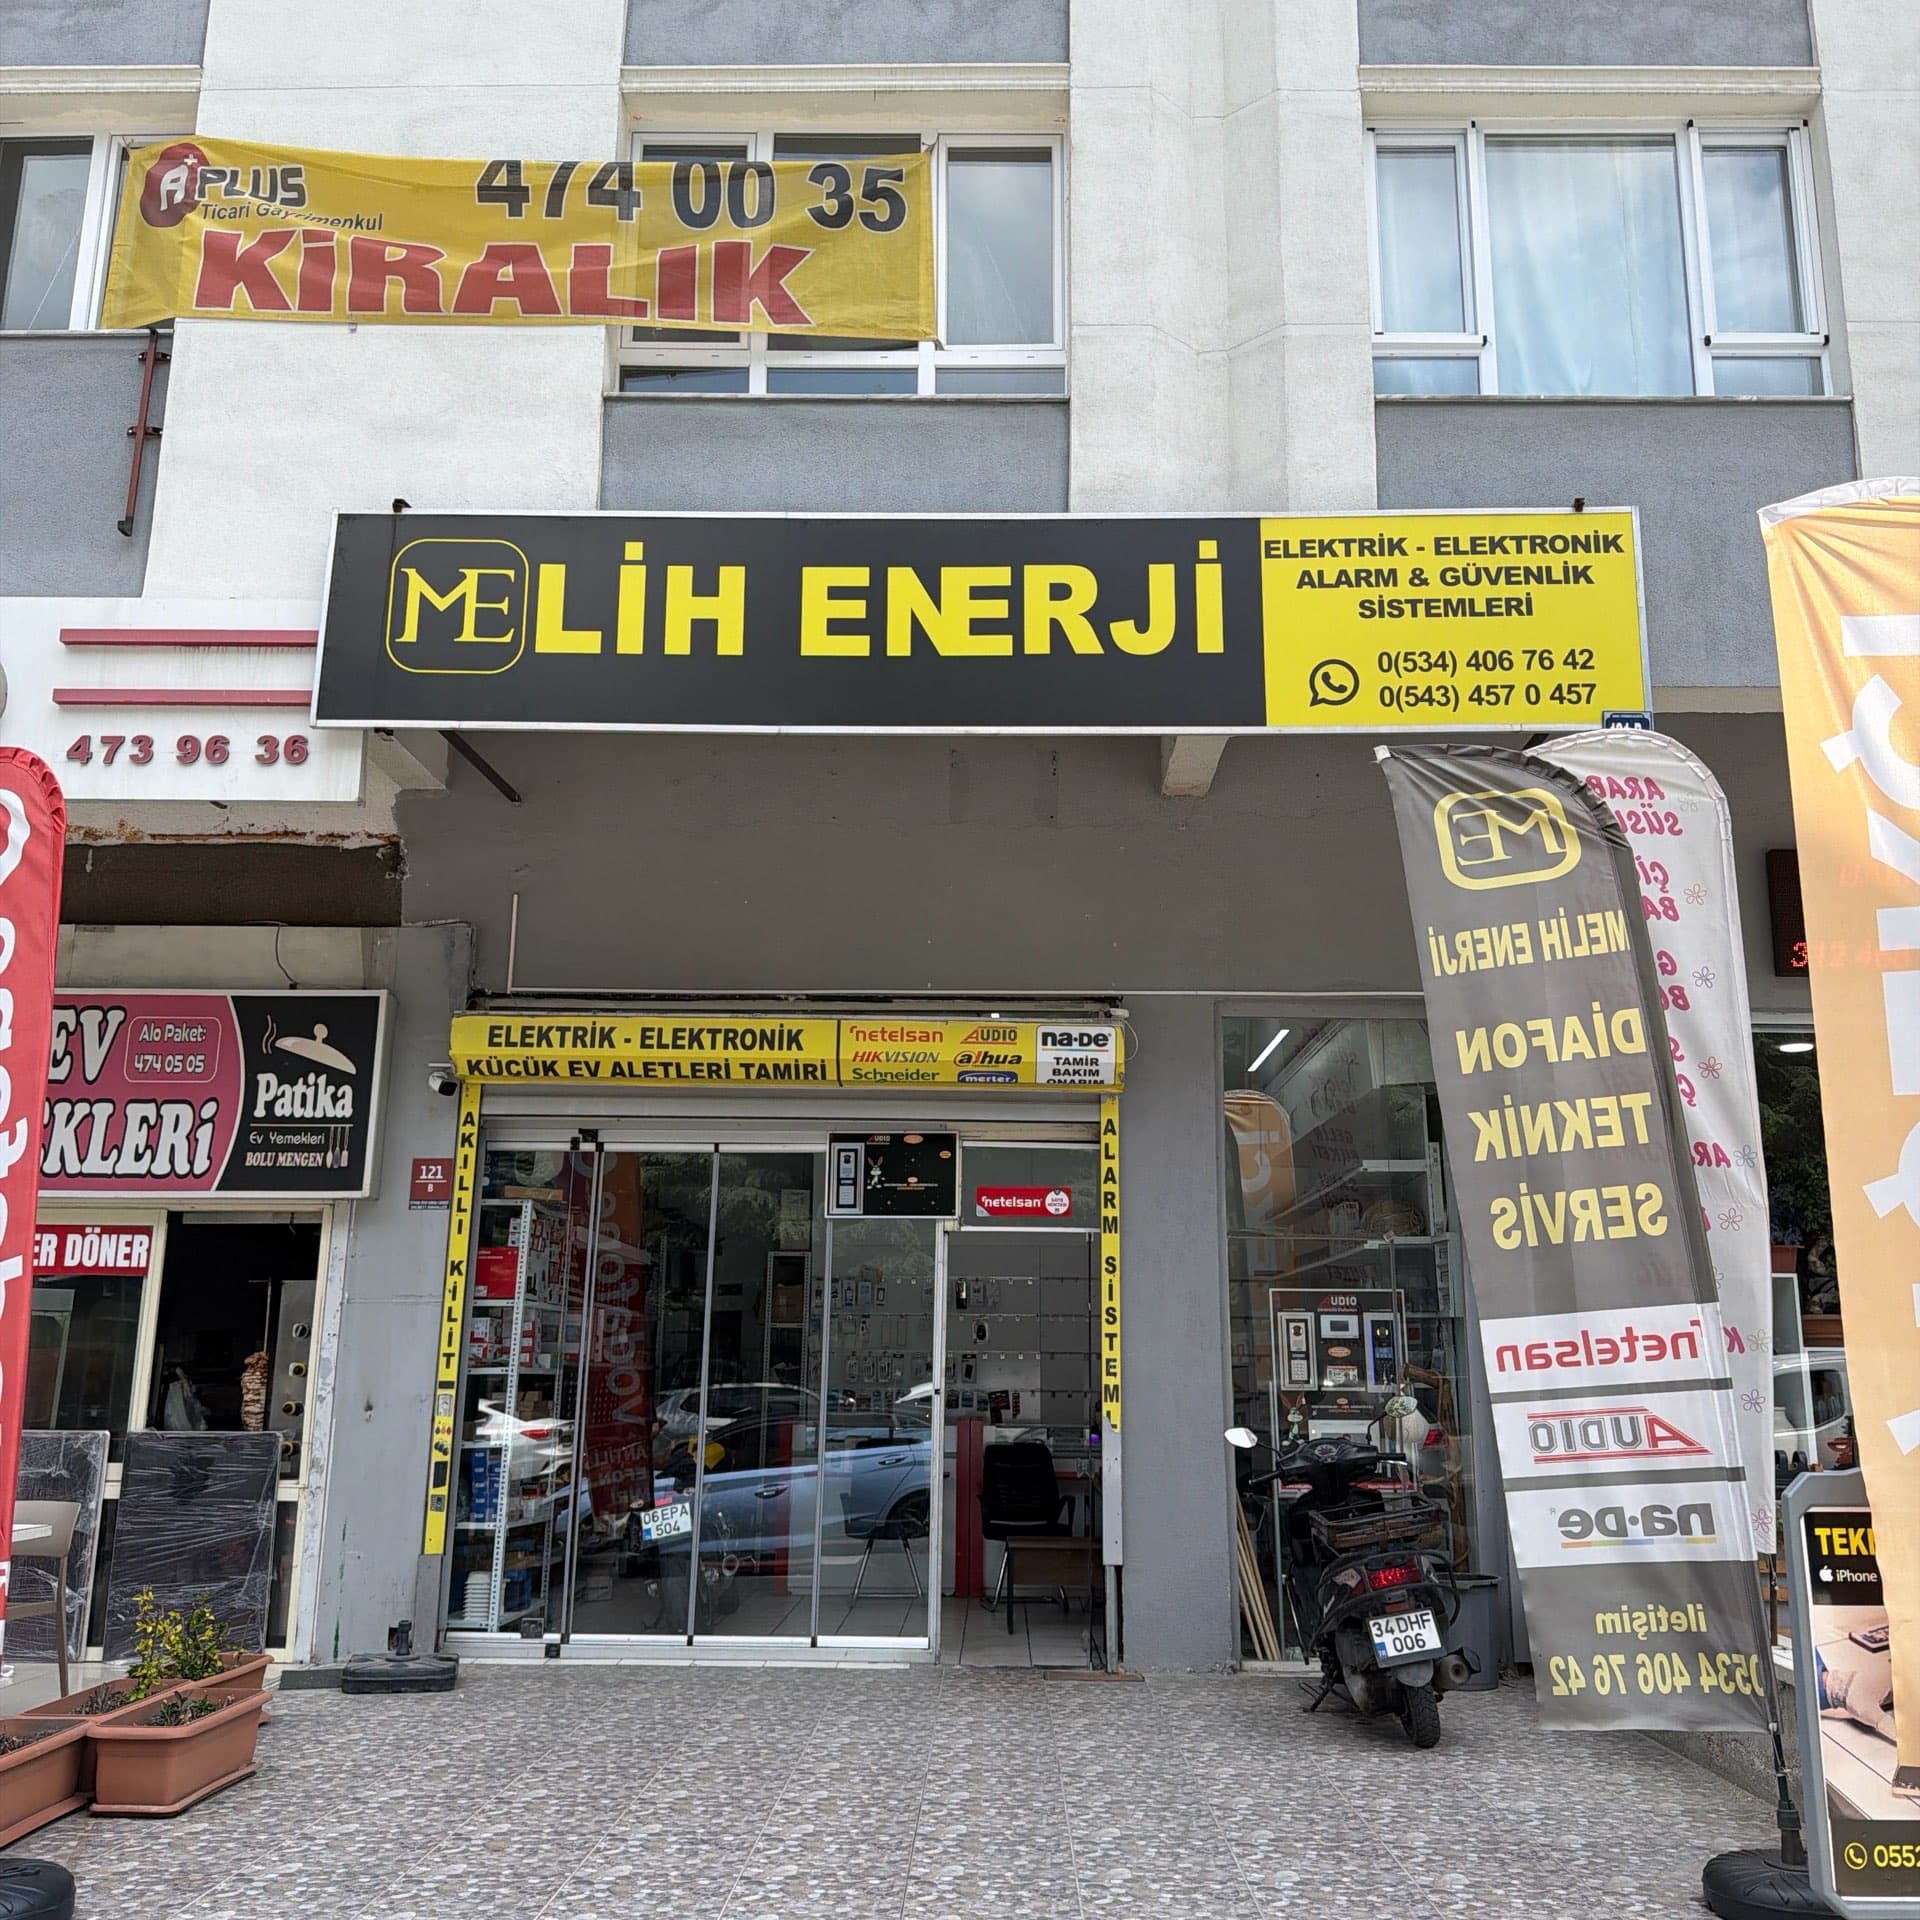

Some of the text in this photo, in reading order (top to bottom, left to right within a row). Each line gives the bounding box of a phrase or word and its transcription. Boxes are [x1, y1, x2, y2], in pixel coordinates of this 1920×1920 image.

[477, 159, 907, 233] 474 00 35
[201, 203, 250, 220] Ticari
[1264, 533, 1409, 559] ELEKTRİK
[1433, 530, 1624, 556] ELEKTRONİK
[1296, 562, 1594, 589] ALARM & GÜVENLİK
[800, 540, 1225, 656] ENERJİ
[1358, 592, 1533, 619] SİSTEMLERİ
[1377, 649, 1594, 676] 0(534) 406 76 42
[1379, 683, 1597, 711] 0(543) 457 0 457
[66, 735, 309, 764] 473 96 36
[139, 1024, 206, 1042] Alo Paket:
[487, 1021, 617, 1049] ELEKTRİK
[639, 1023, 804, 1051] ELEKTRONİK
[960, 1028, 1017, 1043] AUDIO
[48, 1006, 126, 1084] EV
[134, 1054, 205, 1072] 474 05 05
[852, 1051, 940, 1063] HIKVISION
[1053, 1056, 1099, 1066] TAMİR
[568, 1060, 600, 1077] EV
[610, 1058, 731, 1080] ALETLERİ
[740, 1059, 827, 1080] TAMİRİ
[852, 1068, 940, 1081] Schneider
[1052, 1068, 1100, 1077] BAKIM
[253, 1072, 353, 1118] Patika
[249, 1131, 325, 1144] Ev Yemekleri
[245, 1152, 324, 1167] BOLU MENGEN
[420, 1165, 444, 1179] 121
[1102, 1118, 1118, 1234] ALARM
[981, 1196, 1041, 1208] netelsan
[64, 1227, 149, 1268] DÖNER
[443, 1111, 476, 1369] AKILLI KİLİT
[655, 1520, 681, 1537] 504
[1836, 1569, 1878, 1582] iPhone
[1393, 1633, 1426, 1653] 006
